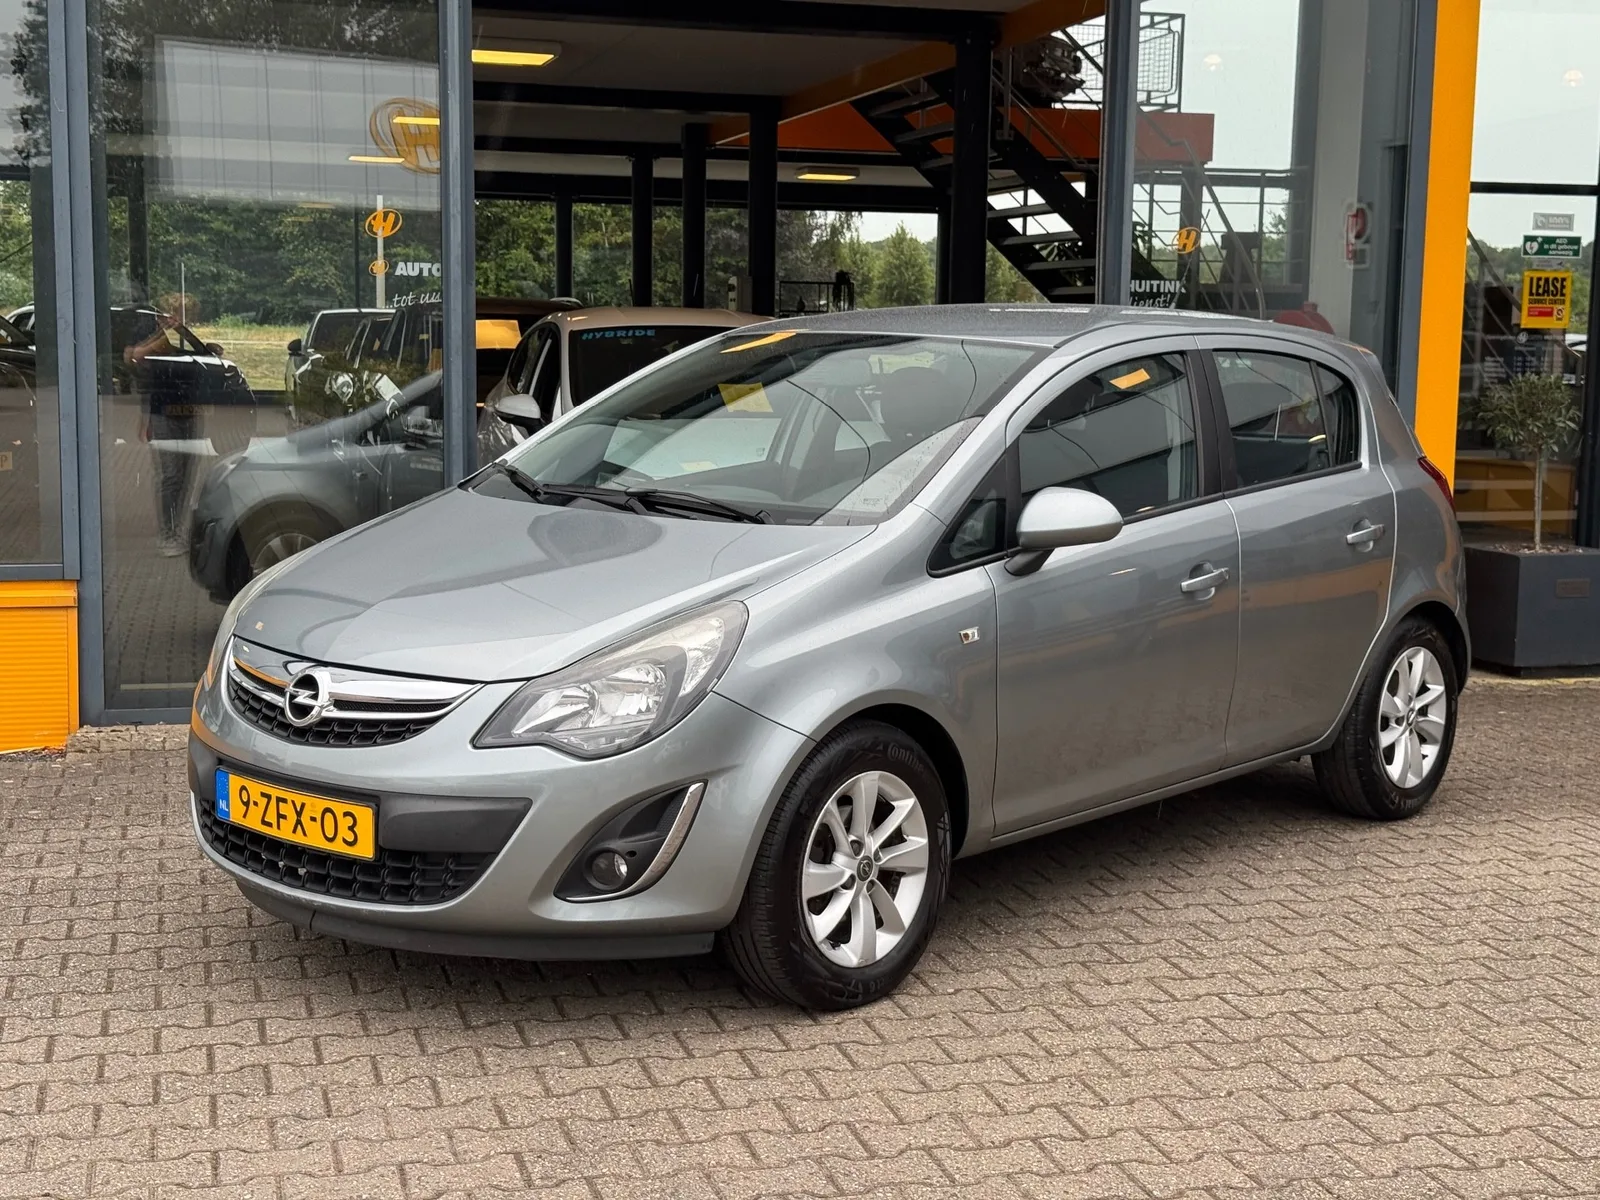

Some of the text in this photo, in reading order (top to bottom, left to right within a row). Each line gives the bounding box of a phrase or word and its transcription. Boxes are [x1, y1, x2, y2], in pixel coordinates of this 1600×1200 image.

[394, 261, 442, 277] AUTO
[1528, 276, 1567, 298] LEASE
[1129, 293, 1171, 307] ienst!
[581, 329, 656, 340] HYBRIDE
[219, 799, 229, 812] NL
[238, 784, 359, 847] 9-ZFX-03
